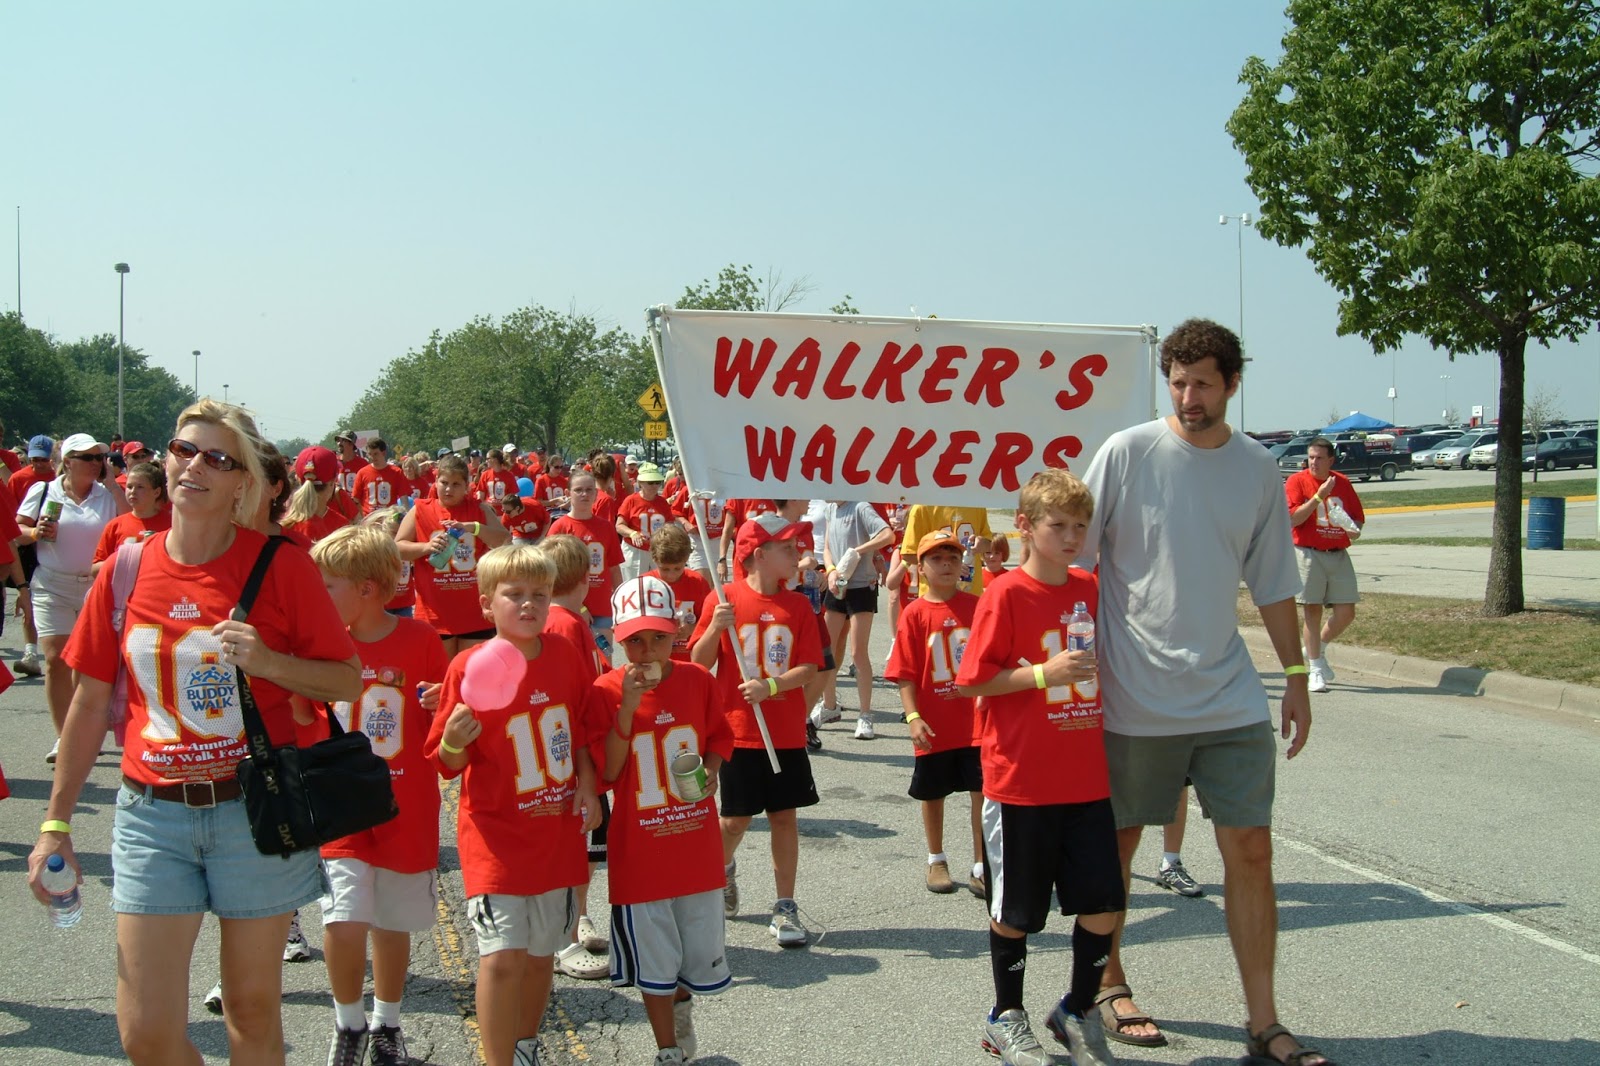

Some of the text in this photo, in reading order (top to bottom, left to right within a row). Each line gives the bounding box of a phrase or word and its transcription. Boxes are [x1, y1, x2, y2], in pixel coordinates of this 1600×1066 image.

[713, 336, 1108, 411] WALKER'S
[744, 423, 1083, 493] WALKERS
[367, 482, 392, 505] 10
[487, 480, 506, 500] 10
[738, 622, 794, 680] 10
[125, 623, 247, 744] 10
[186, 686, 235, 700] BUDDY
[243, 684, 254, 709] JVC
[529, 696, 550, 705] WILLIAMS
[530, 692, 547, 700] KELLER
[191, 697, 233, 711] WALK
[655, 717, 675, 725] WILLIAMS
[1047, 711, 1069, 720] Buddy
[1071, 709, 1088, 717] Walk
[366, 722, 397, 731] BUDDY
[368, 729, 393, 738] WALK
[161, 741, 185, 752] 10th
[253, 735, 268, 760] JVC
[504, 702, 574, 795] 10
[142, 750, 175, 765] Buddy
[177, 751, 215, 763] Walk
[631, 724, 706, 811] 10
[262, 769, 279, 795] JVC
[535, 788, 549, 797] 10th
[518, 797, 542, 810] Buddy
[656, 802, 697, 815] 10th Annual
[639, 816, 665, 827] Buddy
[666, 812, 687, 822] Walk
[687, 806, 710, 818] Festival
[278, 823, 296, 849] JVC
